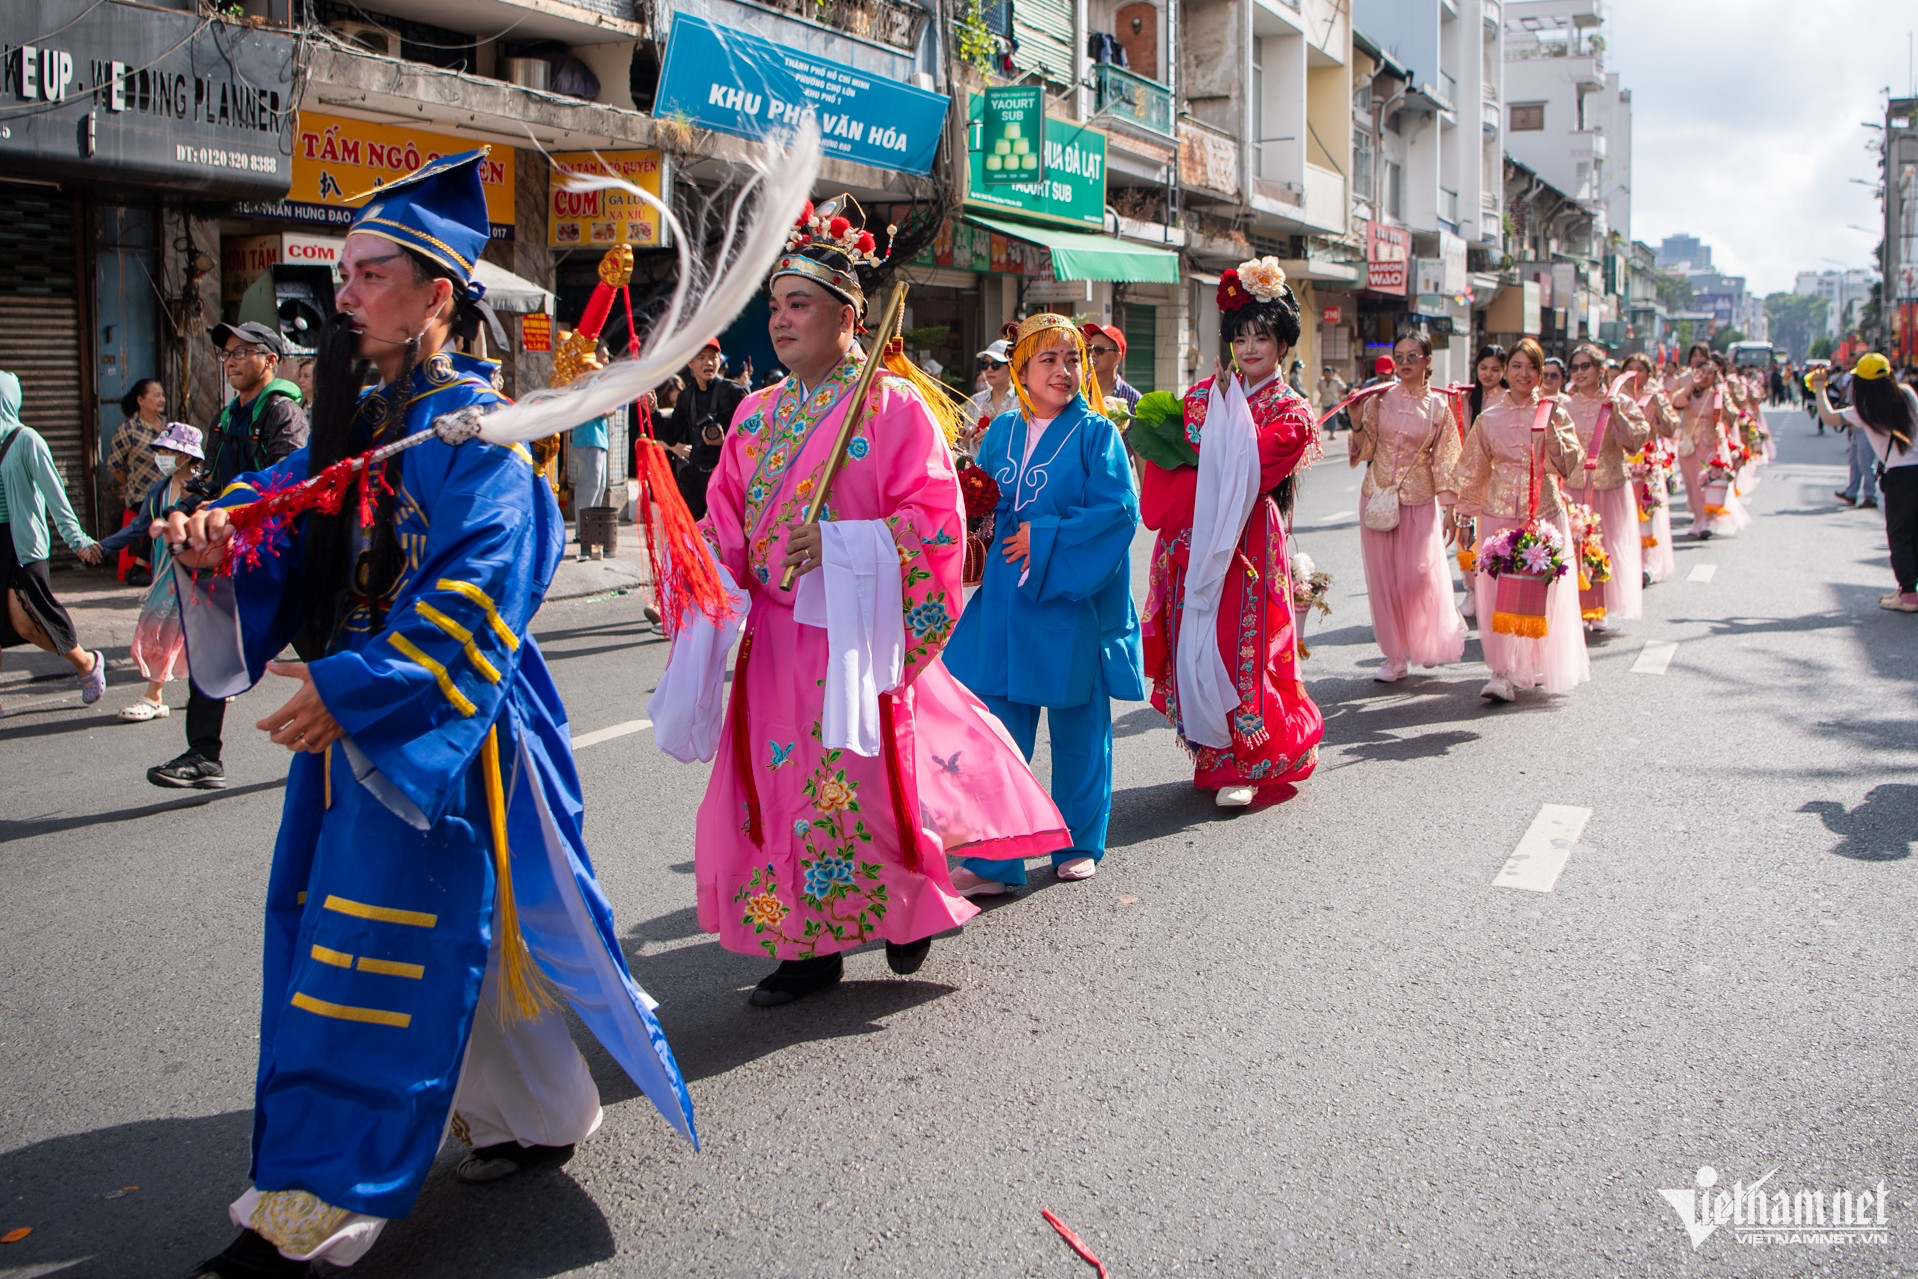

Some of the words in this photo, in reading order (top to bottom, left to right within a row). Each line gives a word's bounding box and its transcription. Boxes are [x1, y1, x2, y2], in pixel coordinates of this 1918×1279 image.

[43, 48, 73, 102] UP
[91, 59, 187, 119] WEDDING
[194, 77, 280, 133] PLANNER
[851, 79, 871, 90] MINH
[991, 98, 1035, 110] YAOURT
[1001, 110, 1024, 121] SUB
[708, 83, 763, 116] KHU
[767, 98, 821, 126] PHỐ
[823, 112, 865, 142] VĂN
[867, 125, 908, 153] HÓA
[200, 147, 227, 168] 0120
[228, 151, 248, 169] 320
[250, 155, 277, 174] 8388
[302, 125, 361, 165] TẤM
[367, 142, 421, 173] NGÔ
[1064, 141, 1081, 175] ĐÀ
[1081, 150, 1103, 185] LẠT
[1051, 180, 1072, 202] SUB
[294, 204, 326, 221] HƯNG
[328, 209, 351, 225] ĐẠO
[492, 229, 507, 239] 017
[249, 241, 277, 271] TẤM
[288, 244, 335, 260] CƠM
[1368, 262, 1402, 273] SAIGON
